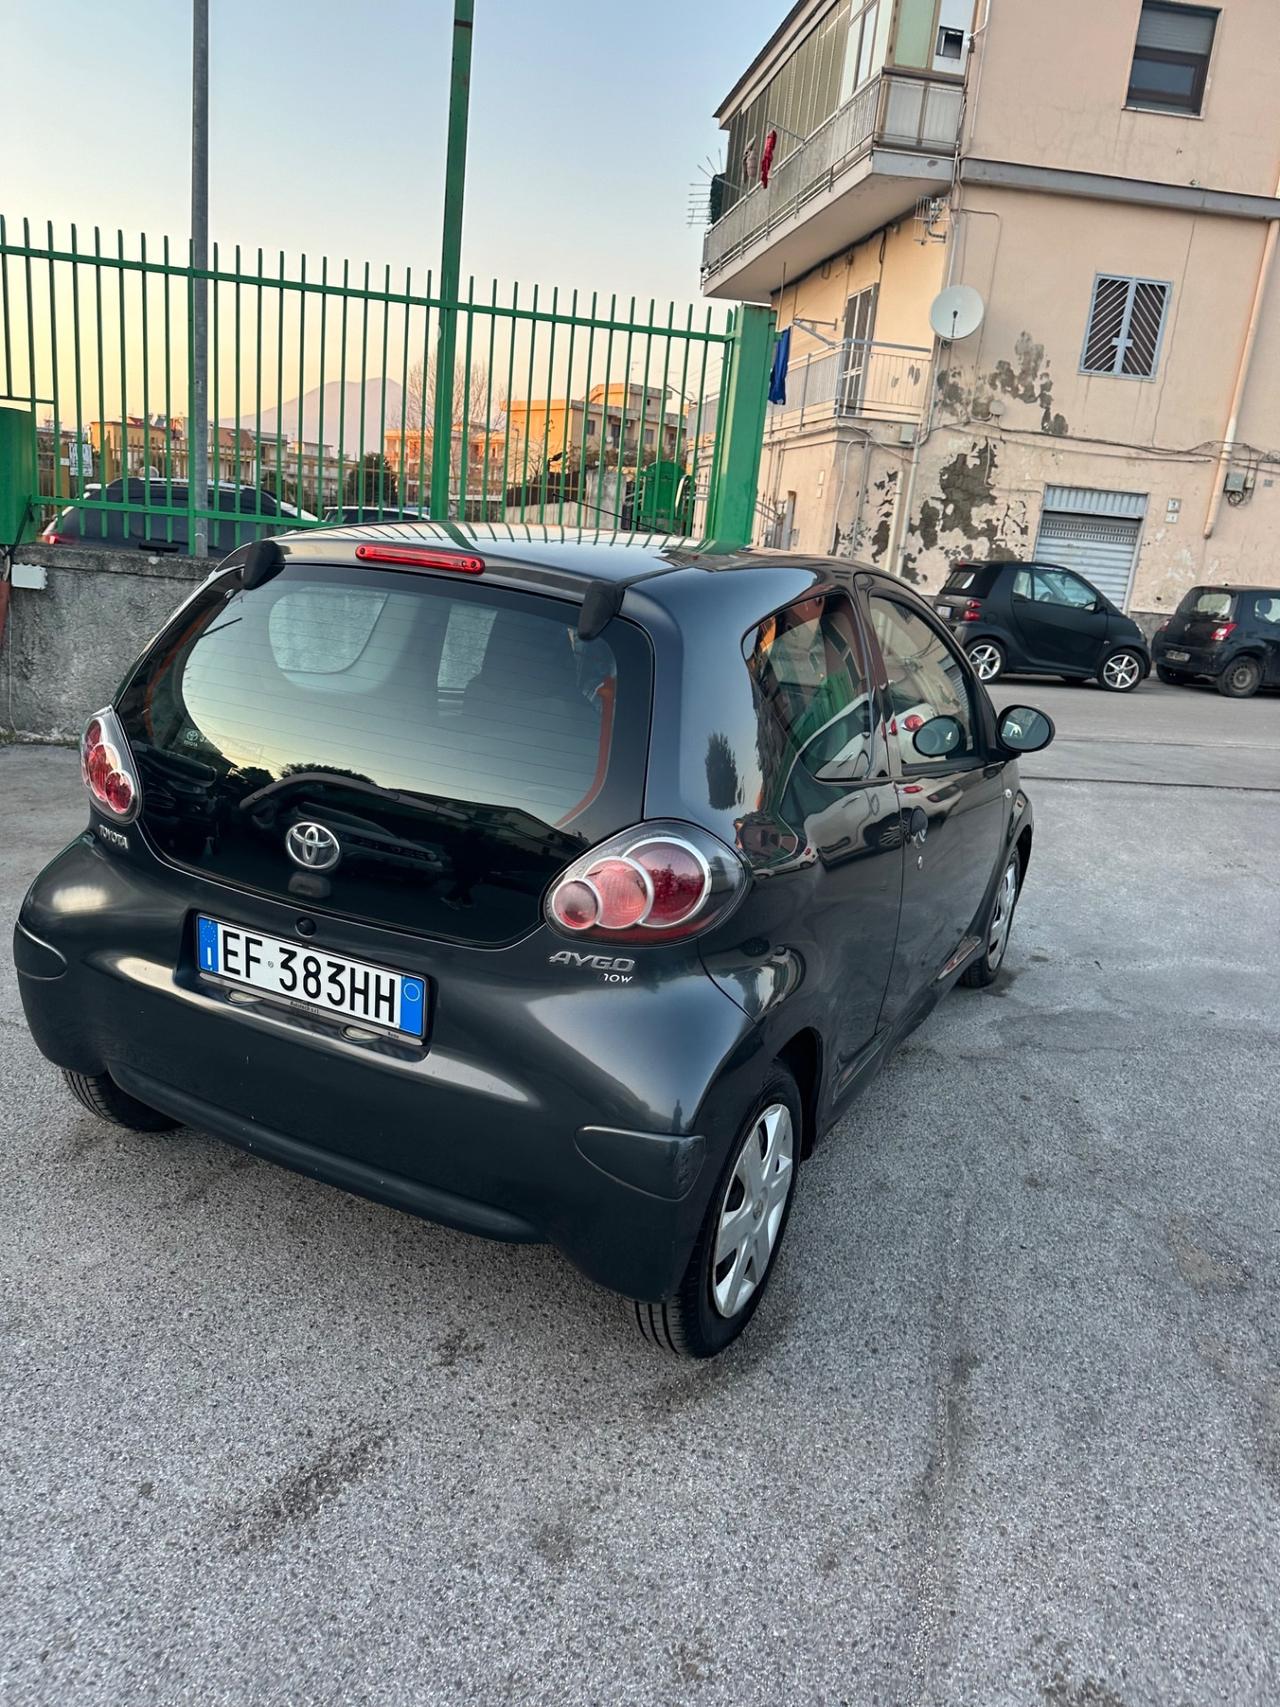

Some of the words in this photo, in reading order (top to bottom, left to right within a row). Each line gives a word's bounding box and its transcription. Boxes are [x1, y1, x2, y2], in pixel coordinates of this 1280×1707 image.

[99, 824, 129, 849] TOYOTA
[549, 950, 635, 972] AYGO
[222, 930, 263, 978] EF
[279, 947, 395, 1023] 383HH
